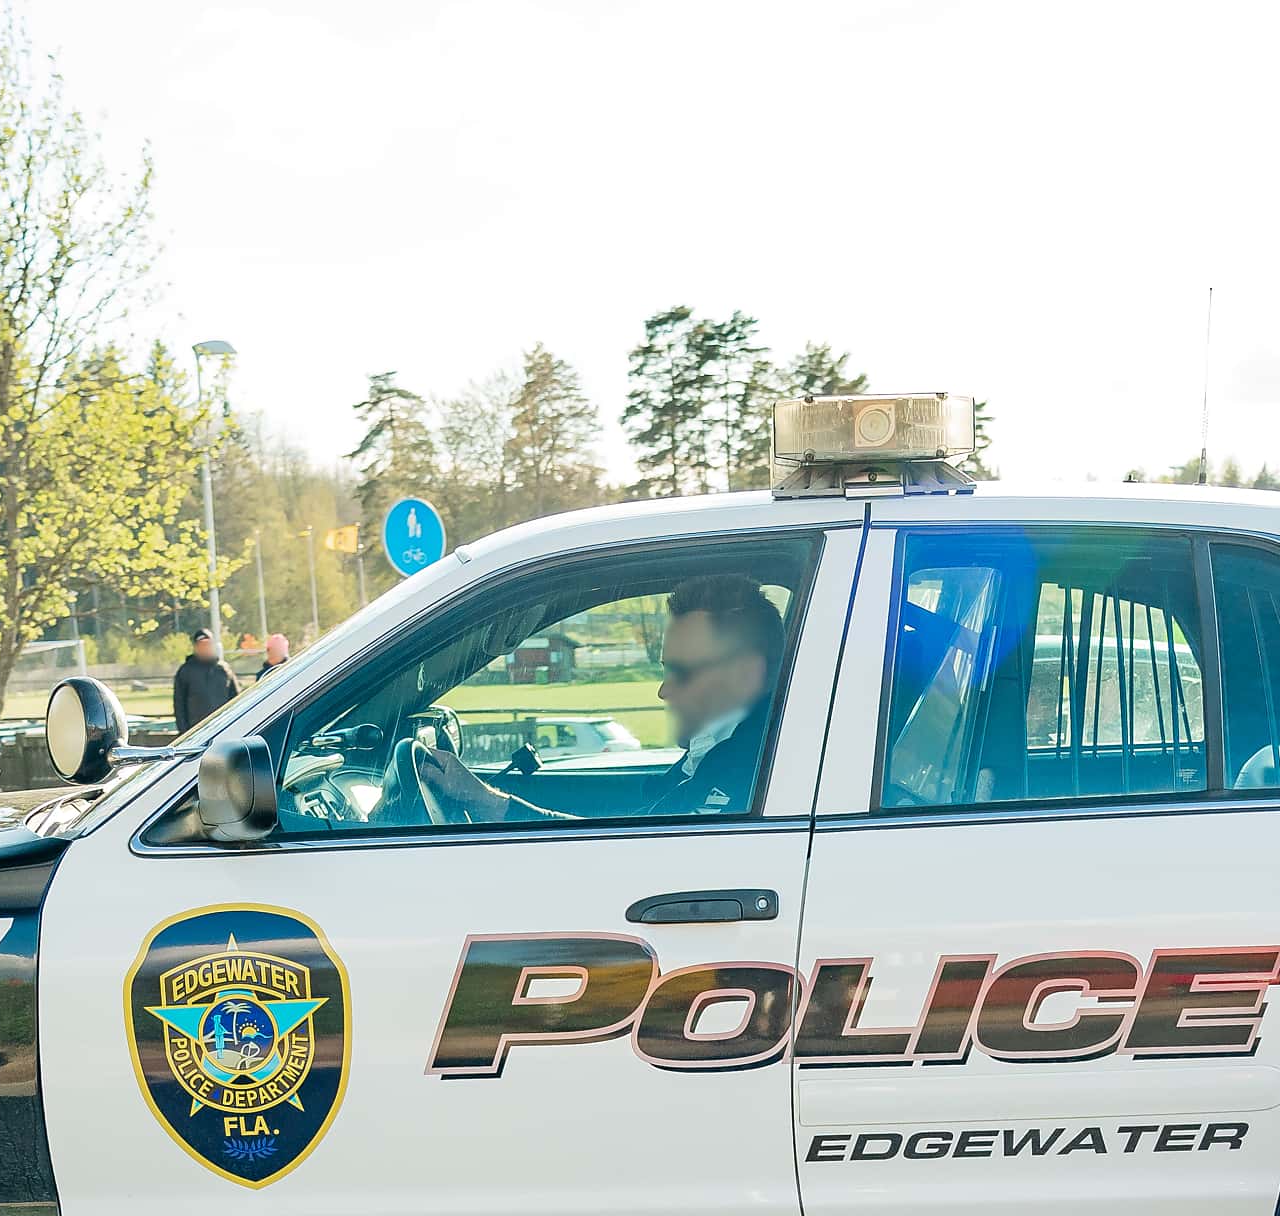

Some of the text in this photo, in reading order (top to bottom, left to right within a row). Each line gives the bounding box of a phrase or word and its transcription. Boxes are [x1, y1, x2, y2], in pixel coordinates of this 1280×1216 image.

[172, 958, 301, 1002] EDGEWATER
[170, 1033, 309, 1108] POLICE DEPARTMENT
[223, 1115, 280, 1137] FLA.
[805, 1121, 1250, 1162] EDGEWATER
